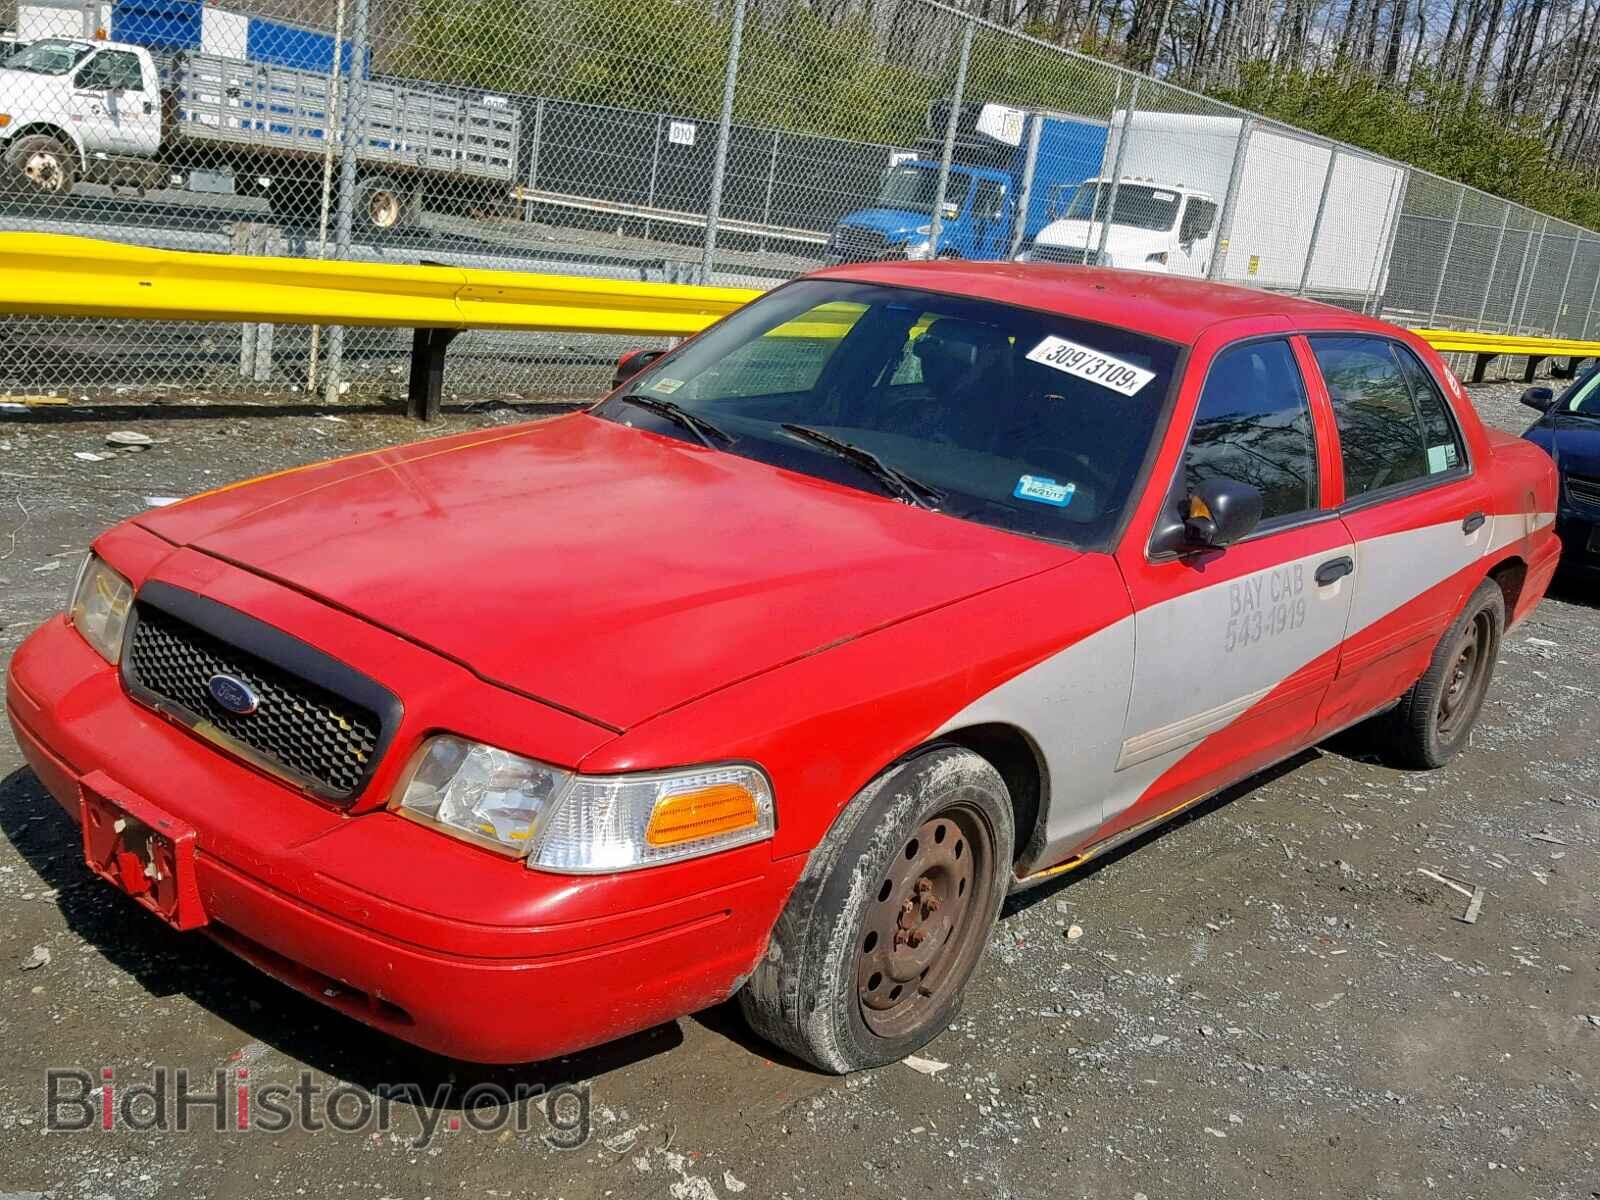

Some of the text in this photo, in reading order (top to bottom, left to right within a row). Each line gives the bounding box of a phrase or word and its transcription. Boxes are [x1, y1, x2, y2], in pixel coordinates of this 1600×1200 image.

[1230, 564, 1304, 618] BAY CAB
[1225, 598, 1305, 653] 543-1919
[217, 681, 243, 706] Ford
